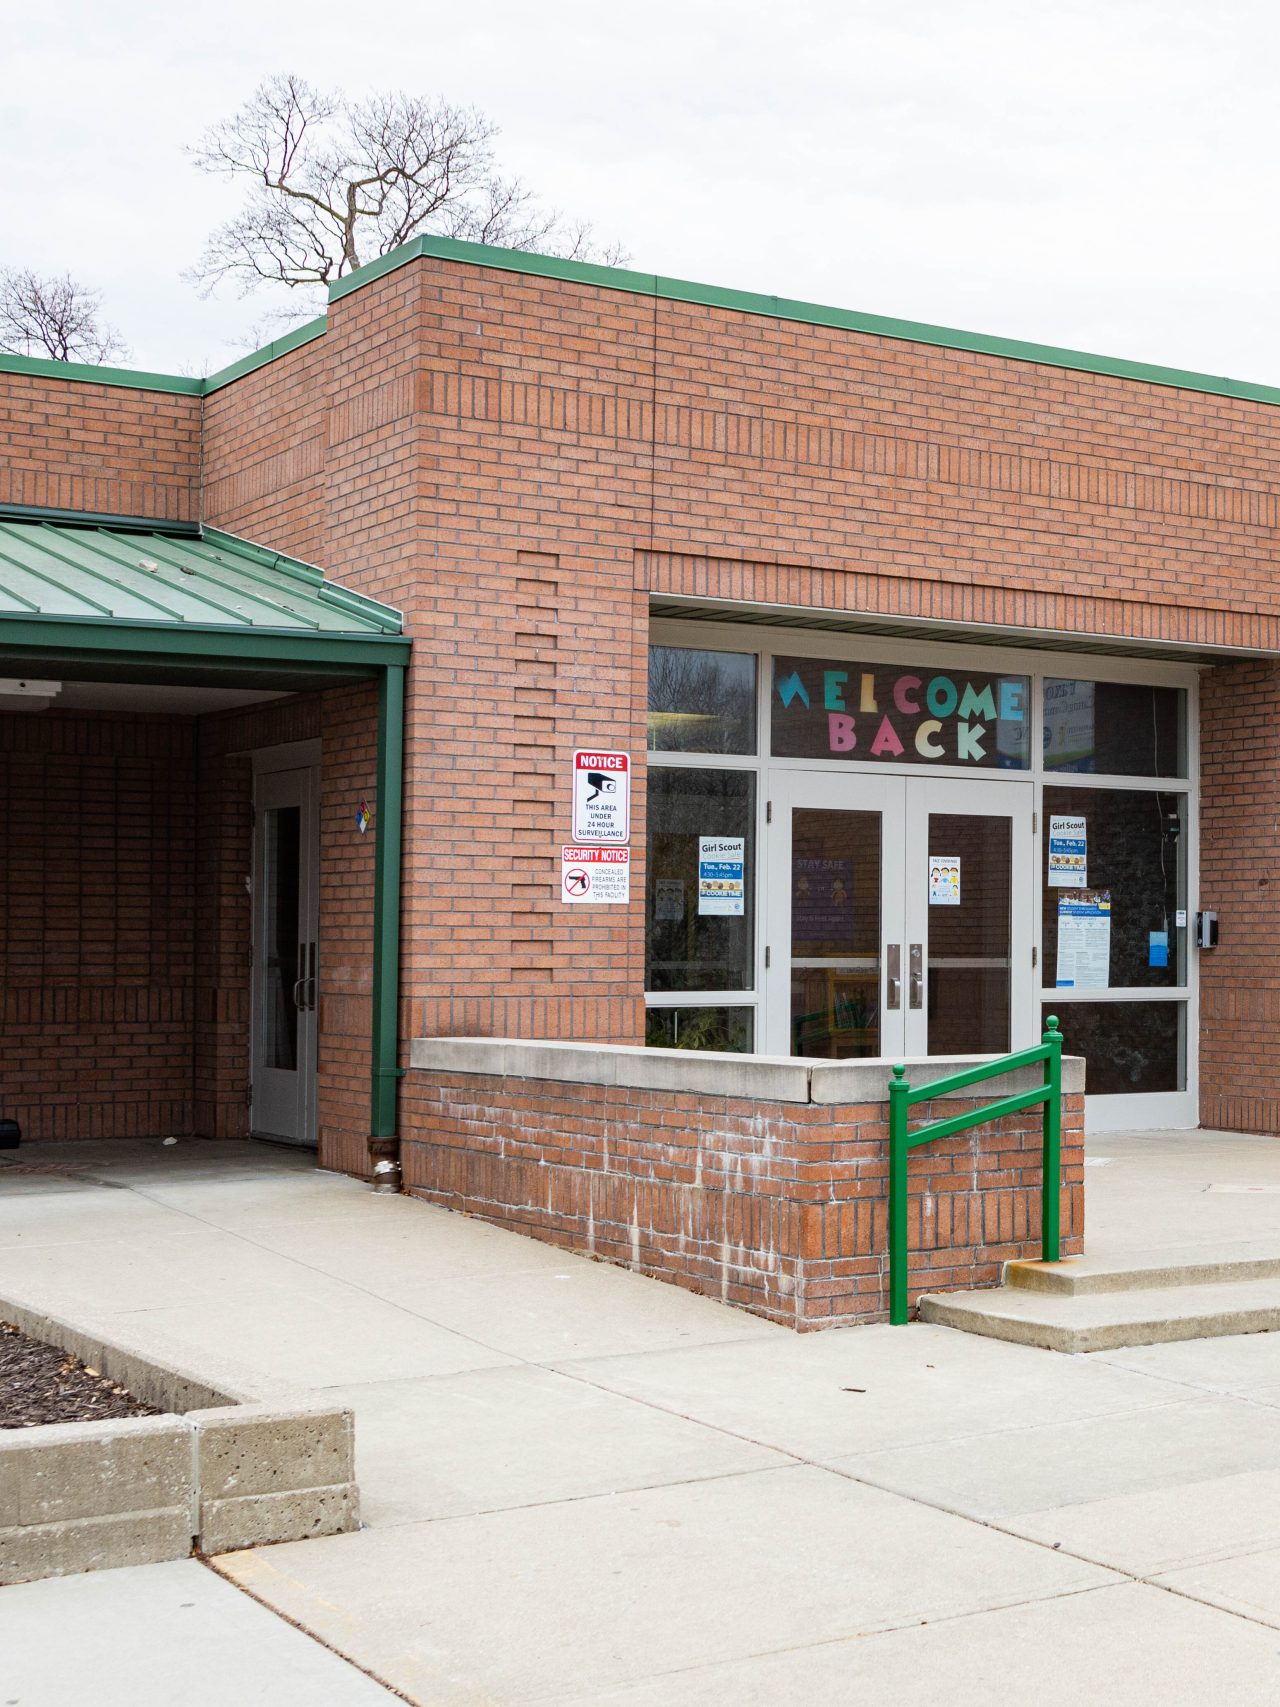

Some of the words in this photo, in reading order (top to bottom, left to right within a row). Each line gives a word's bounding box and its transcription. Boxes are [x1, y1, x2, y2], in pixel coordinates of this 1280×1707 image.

[828, 713, 987, 761] BACK
[580, 755, 623, 768] NOTICE
[1052, 822, 1065, 830] Girl
[1066, 821, 1085, 830] Scout
[578, 829, 623, 837] SURVEILLANCE
[702, 843, 717, 852] Girl
[718, 843, 742, 852] Scout
[564, 849, 599, 861] SECURITY
[601, 850, 628, 862] NOTICE
[797, 859, 820, 869] STAY
[822, 860, 845, 870] SAFE
